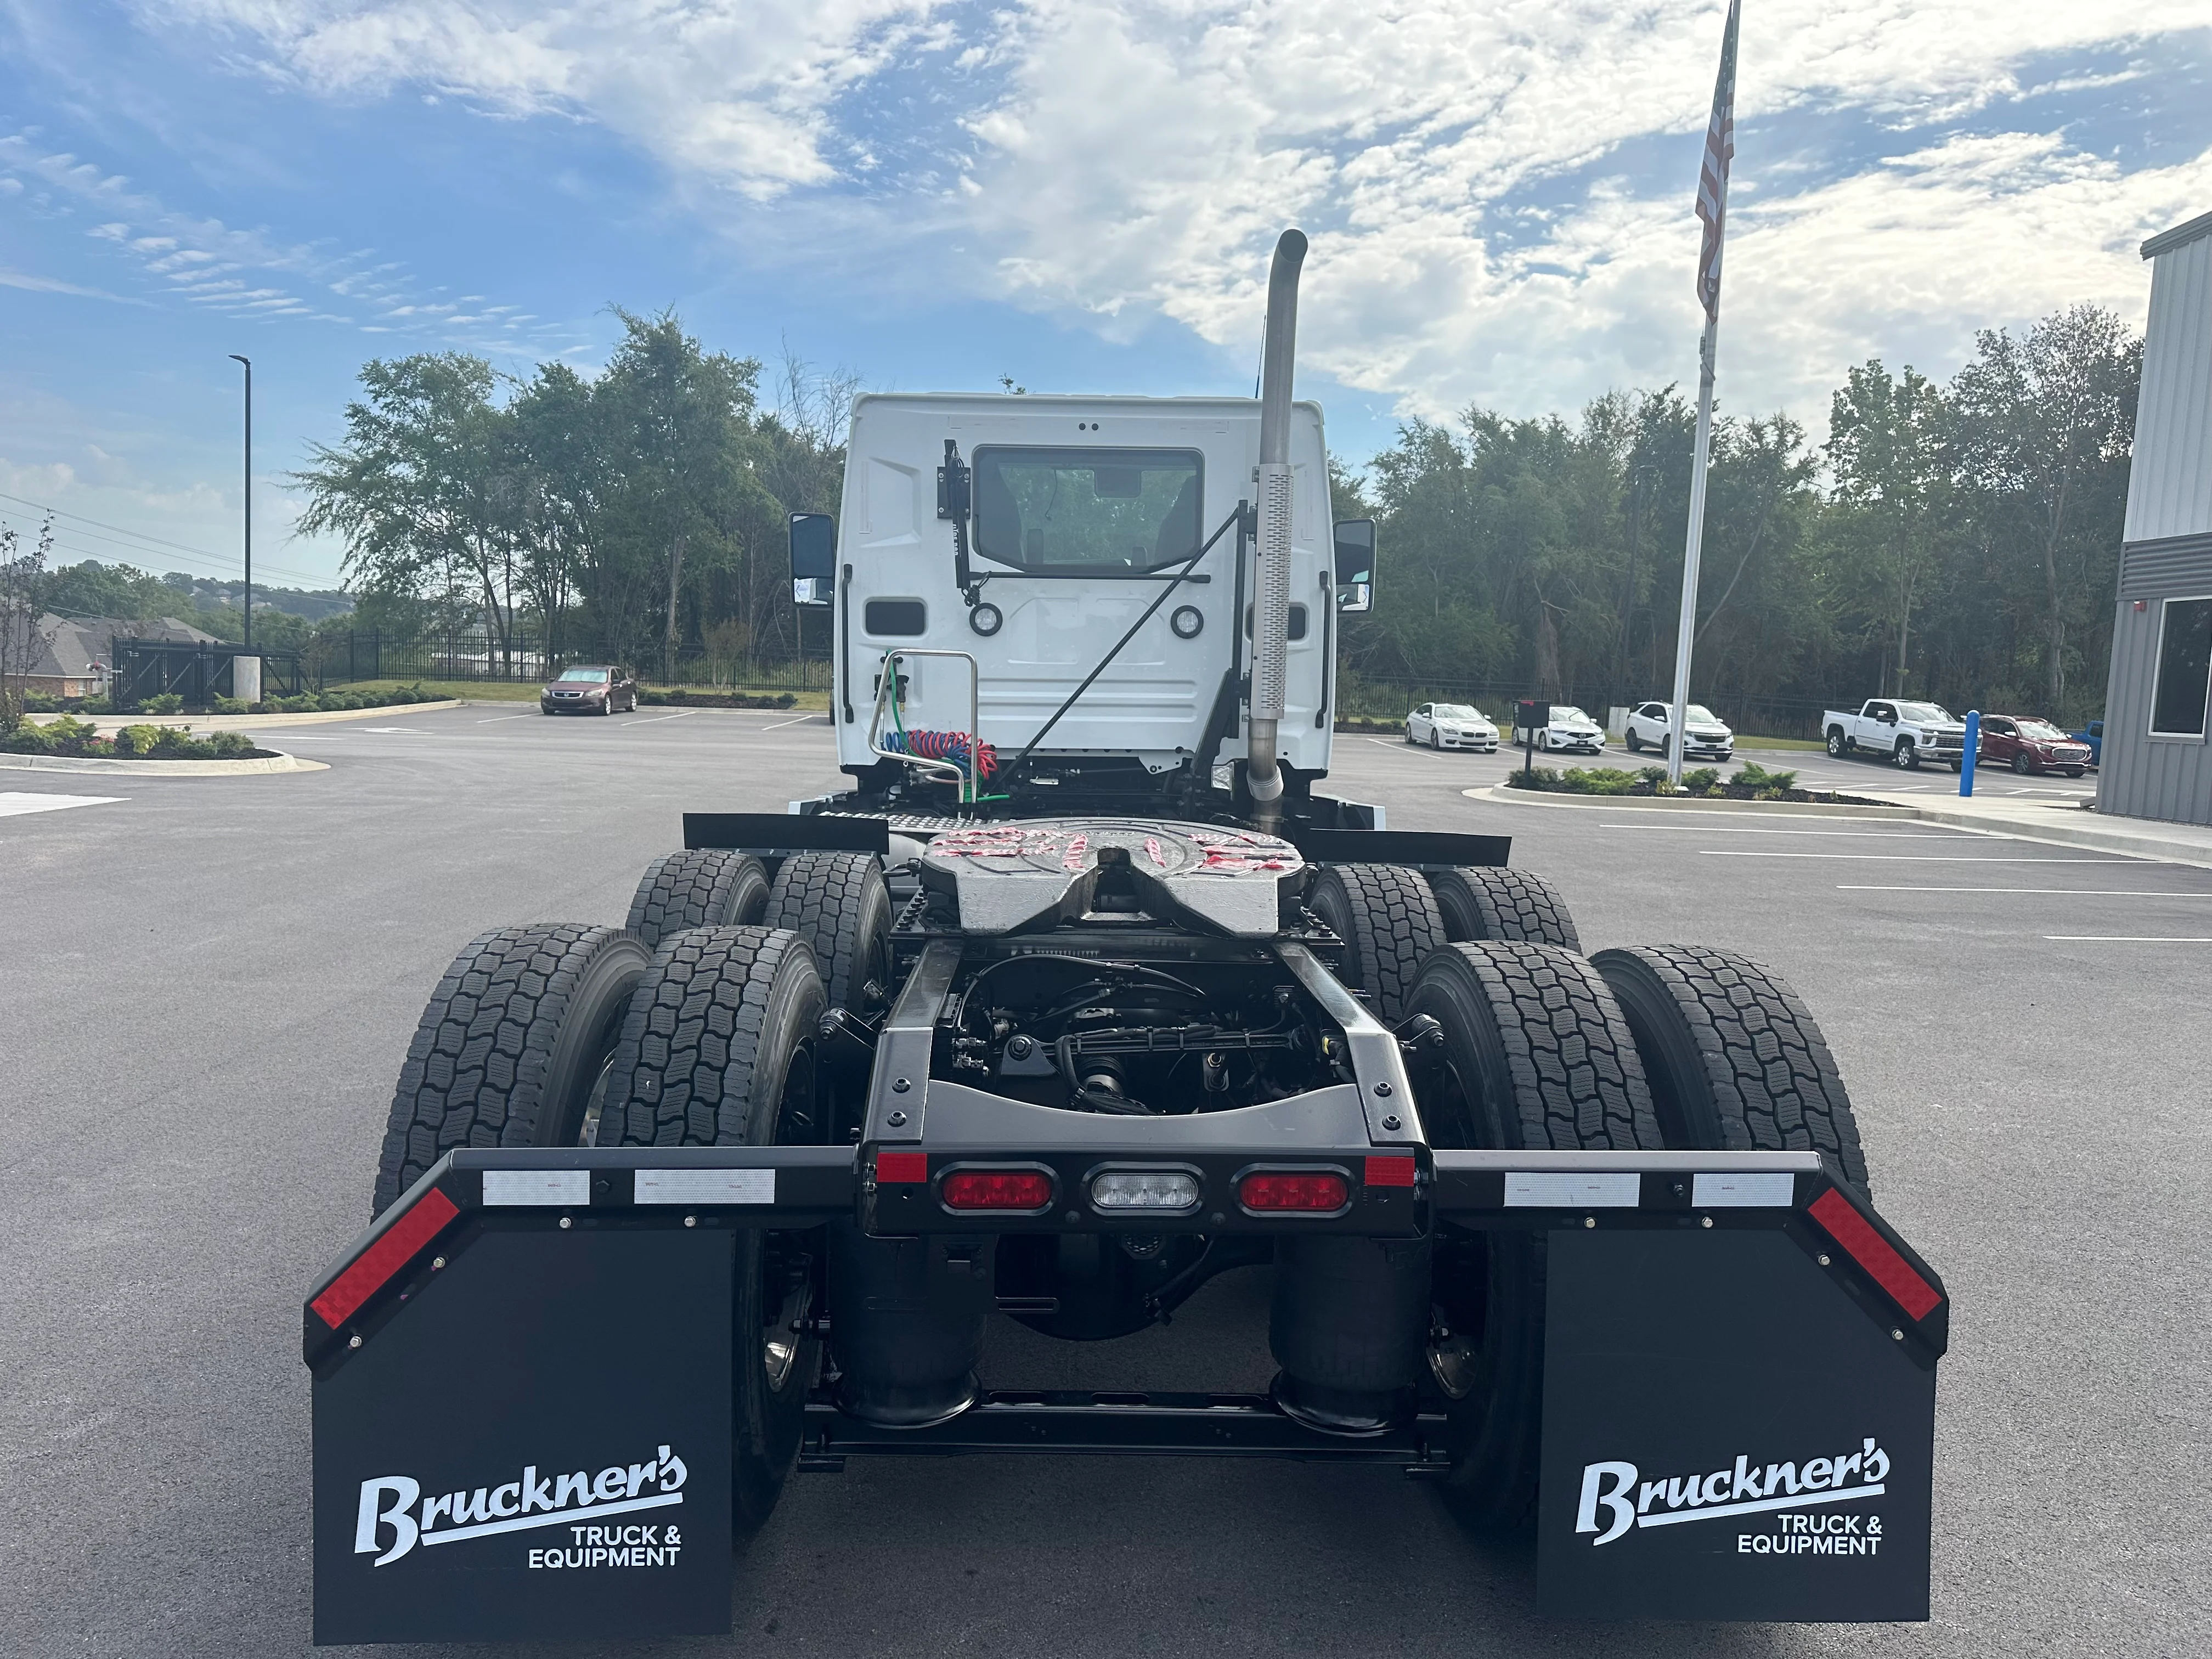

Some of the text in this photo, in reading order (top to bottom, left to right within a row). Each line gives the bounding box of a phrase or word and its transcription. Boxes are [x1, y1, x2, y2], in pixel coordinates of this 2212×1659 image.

[1575, 1438, 1890, 1546] Bruckner's
[354, 1445, 687, 1567] Bruckner's
[1778, 1514, 1882, 1534] TRUCK &
[570, 1525, 681, 1546] TRUCK &
[1737, 1535, 1882, 1555] EQUIPMENT
[529, 1547, 681, 1568] EQUIPMENT
